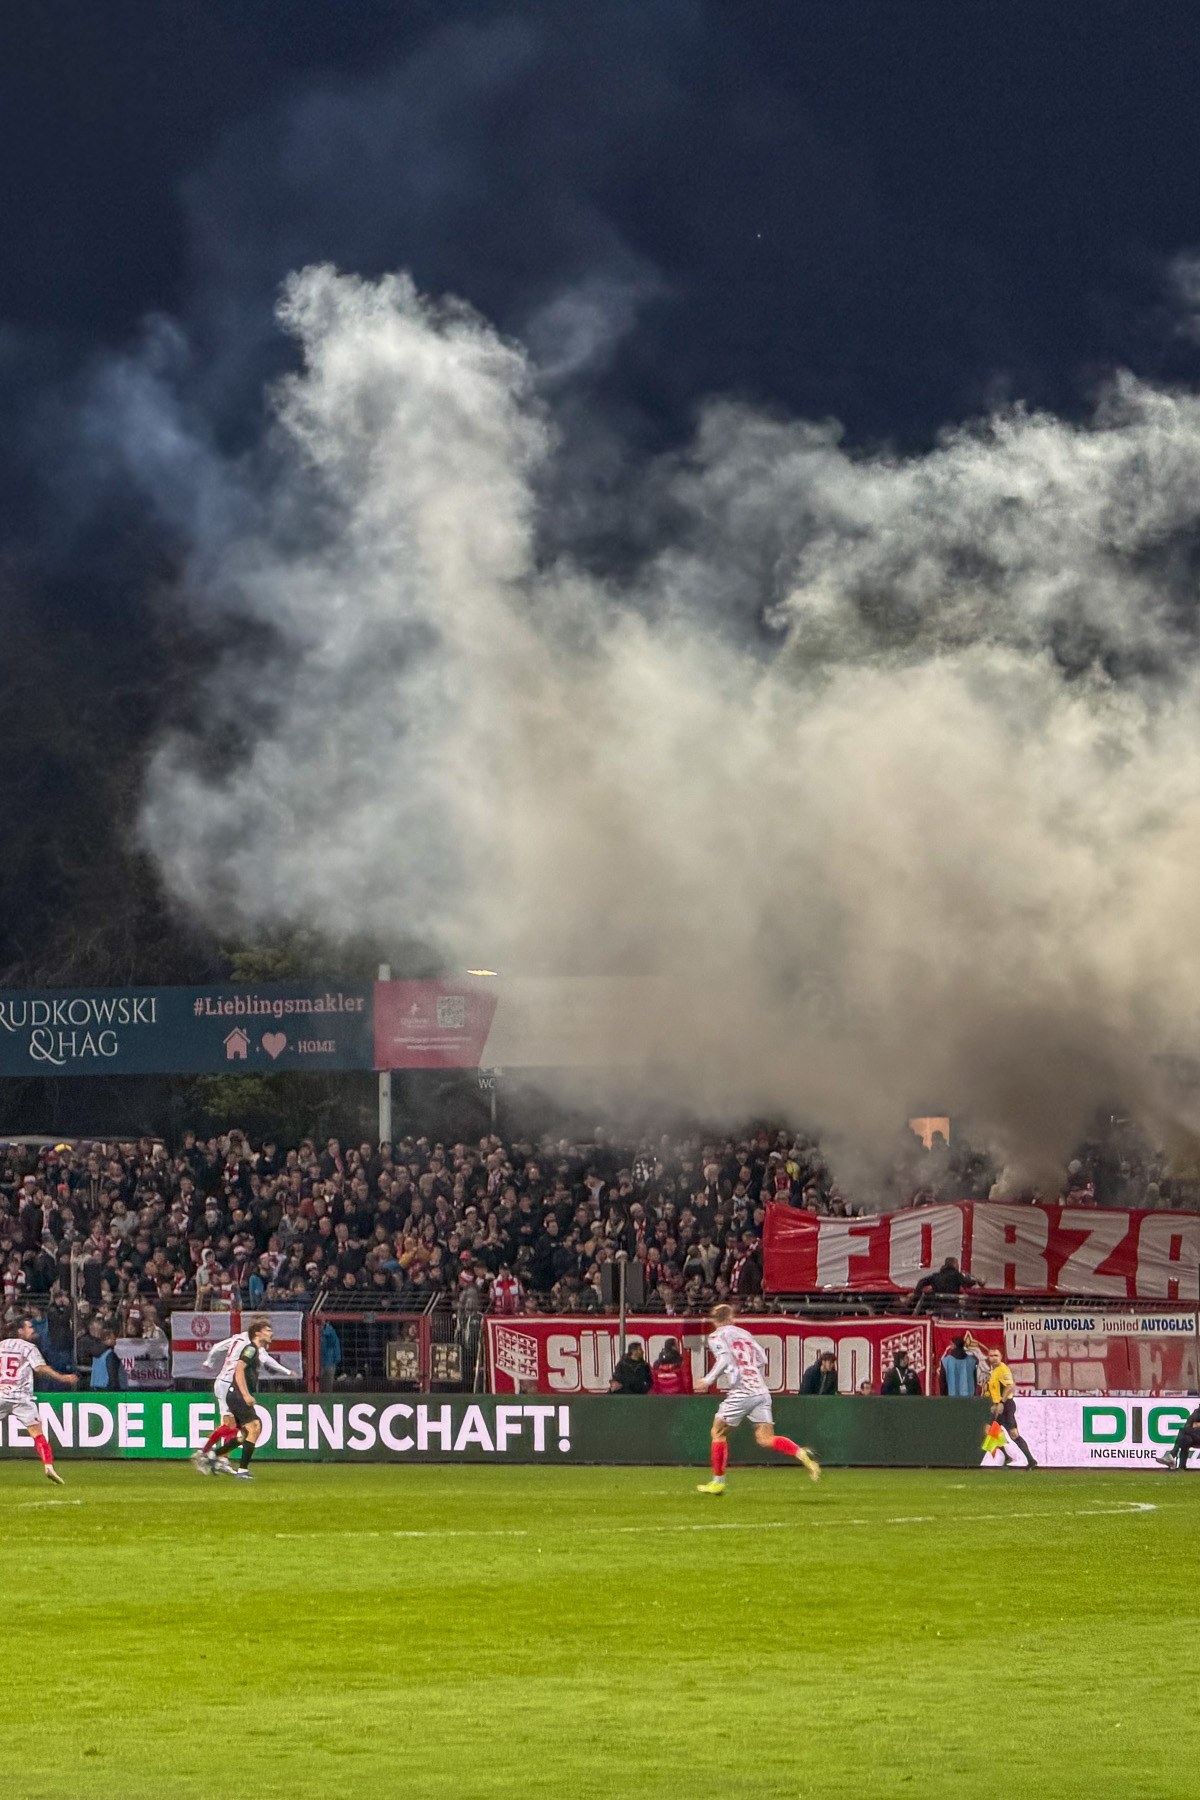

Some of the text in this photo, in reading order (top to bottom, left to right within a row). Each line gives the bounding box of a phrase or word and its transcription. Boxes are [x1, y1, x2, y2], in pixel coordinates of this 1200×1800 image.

[193, 992, 365, 1019] #Lieblingsmakler
[29, 1027, 118, 1065] &HAG
[298, 1040, 336, 1053] HOME
[478, 1078, 496, 1089] WC
[1006, 1317, 1194, 1332] junited AUTOGLAS junited AUTOGLAS
[0, 1402, 571, 1452] ENDE LEDENSCHAFT!
[1090, 1448, 1157, 1460] INGENIEURE
